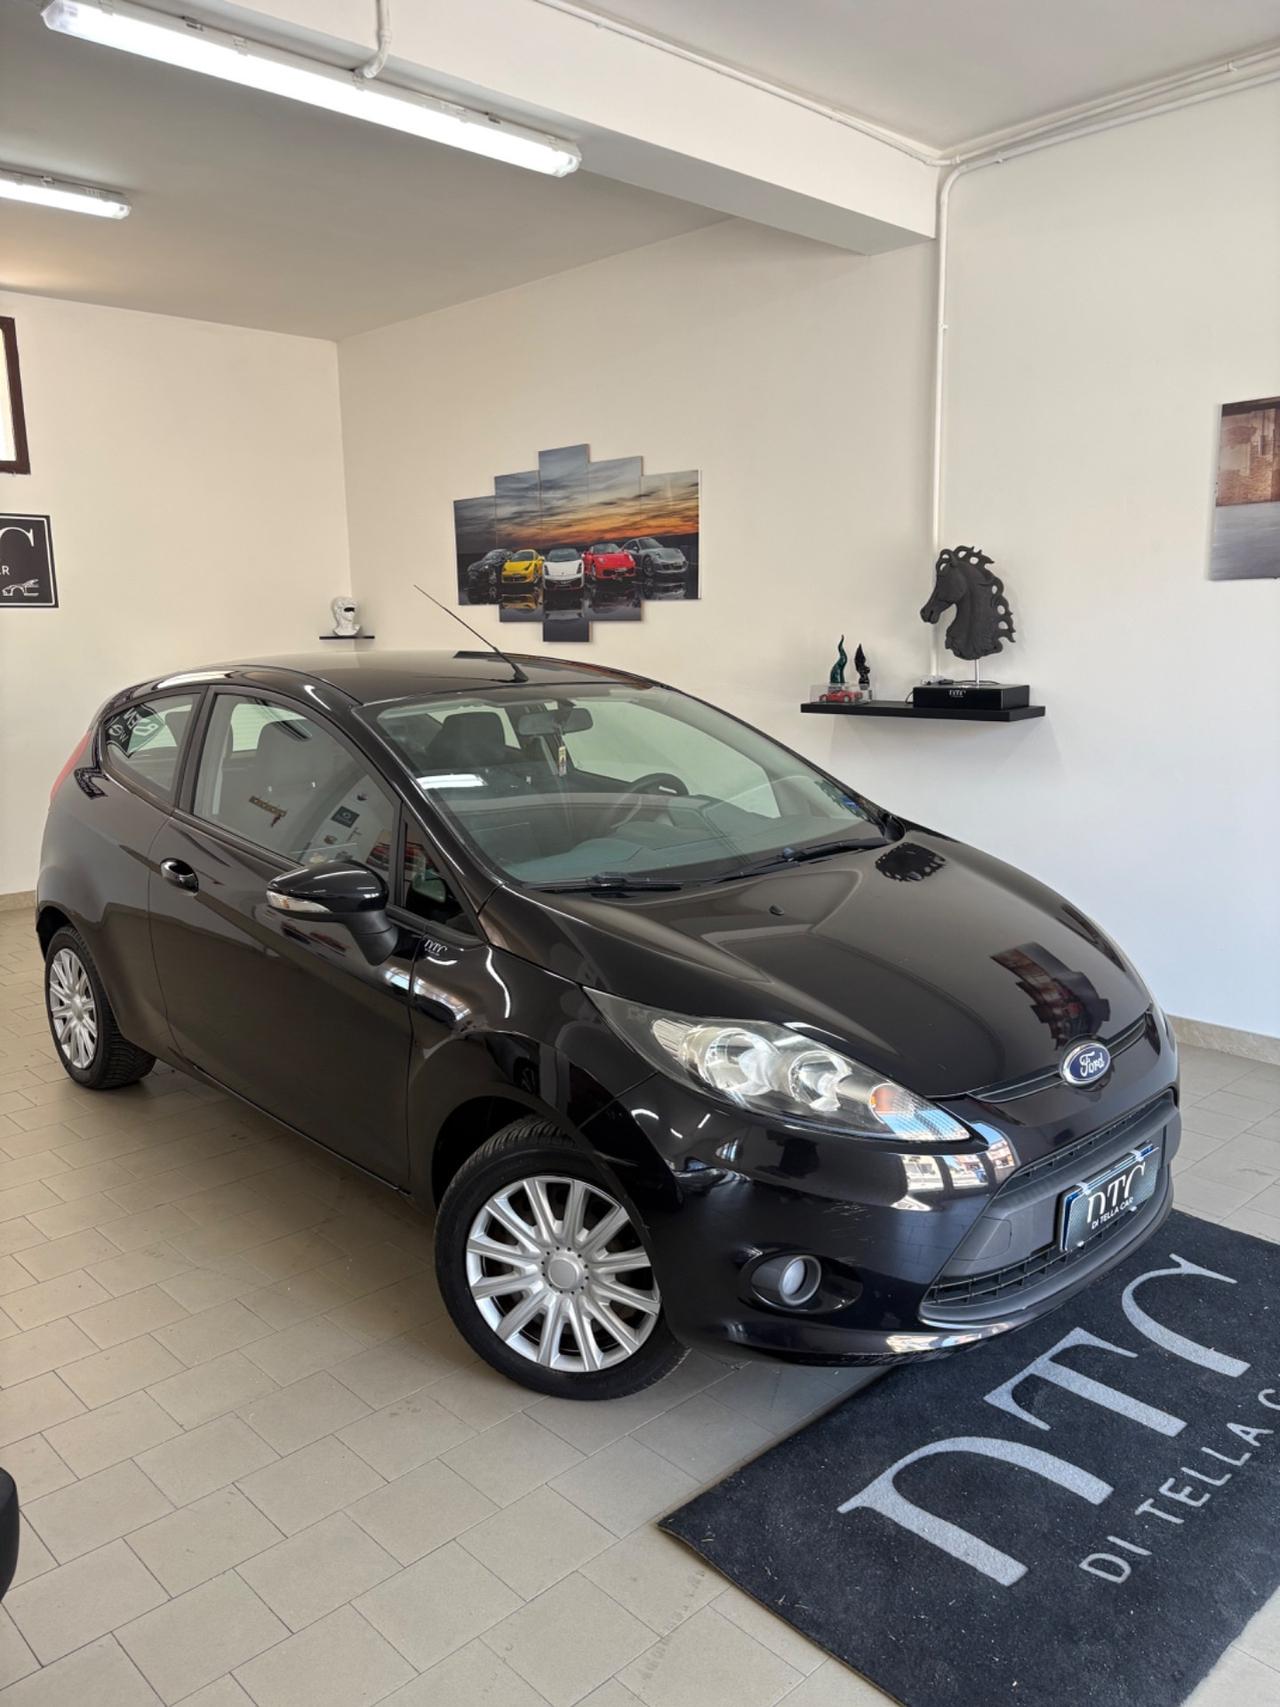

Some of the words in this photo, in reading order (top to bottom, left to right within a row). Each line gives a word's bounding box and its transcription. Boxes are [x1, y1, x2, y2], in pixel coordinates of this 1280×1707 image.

[1079, 1051, 1105, 1077] Ford
[1100, 1206, 1119, 1224] TELLA
[1078, 1532, 1153, 1584] DI
[1134, 1421, 1275, 1524] TELLA
